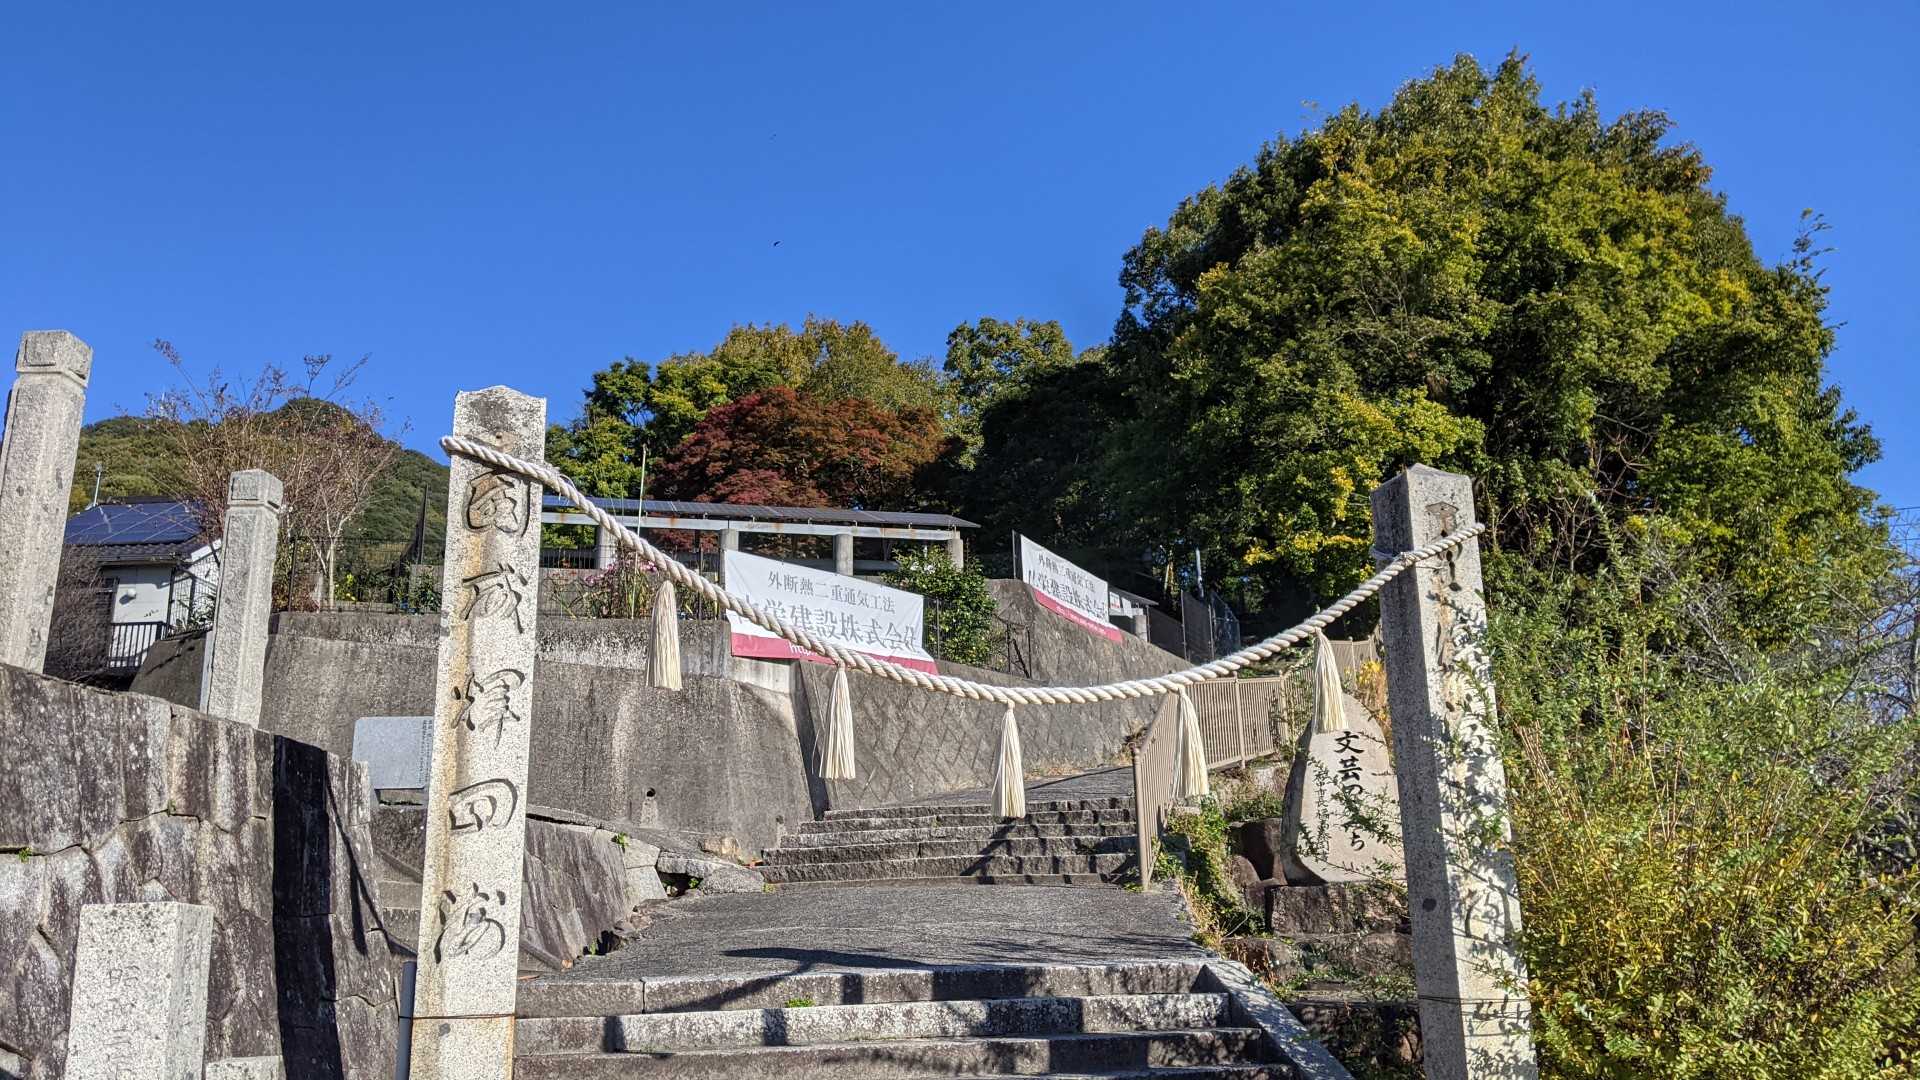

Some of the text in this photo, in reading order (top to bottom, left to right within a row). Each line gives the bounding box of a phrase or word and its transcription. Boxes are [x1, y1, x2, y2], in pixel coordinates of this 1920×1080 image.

[767, 570, 896, 615] 外断熱二重通気工法
[1333, 730, 1365, 851] 文芸のち
